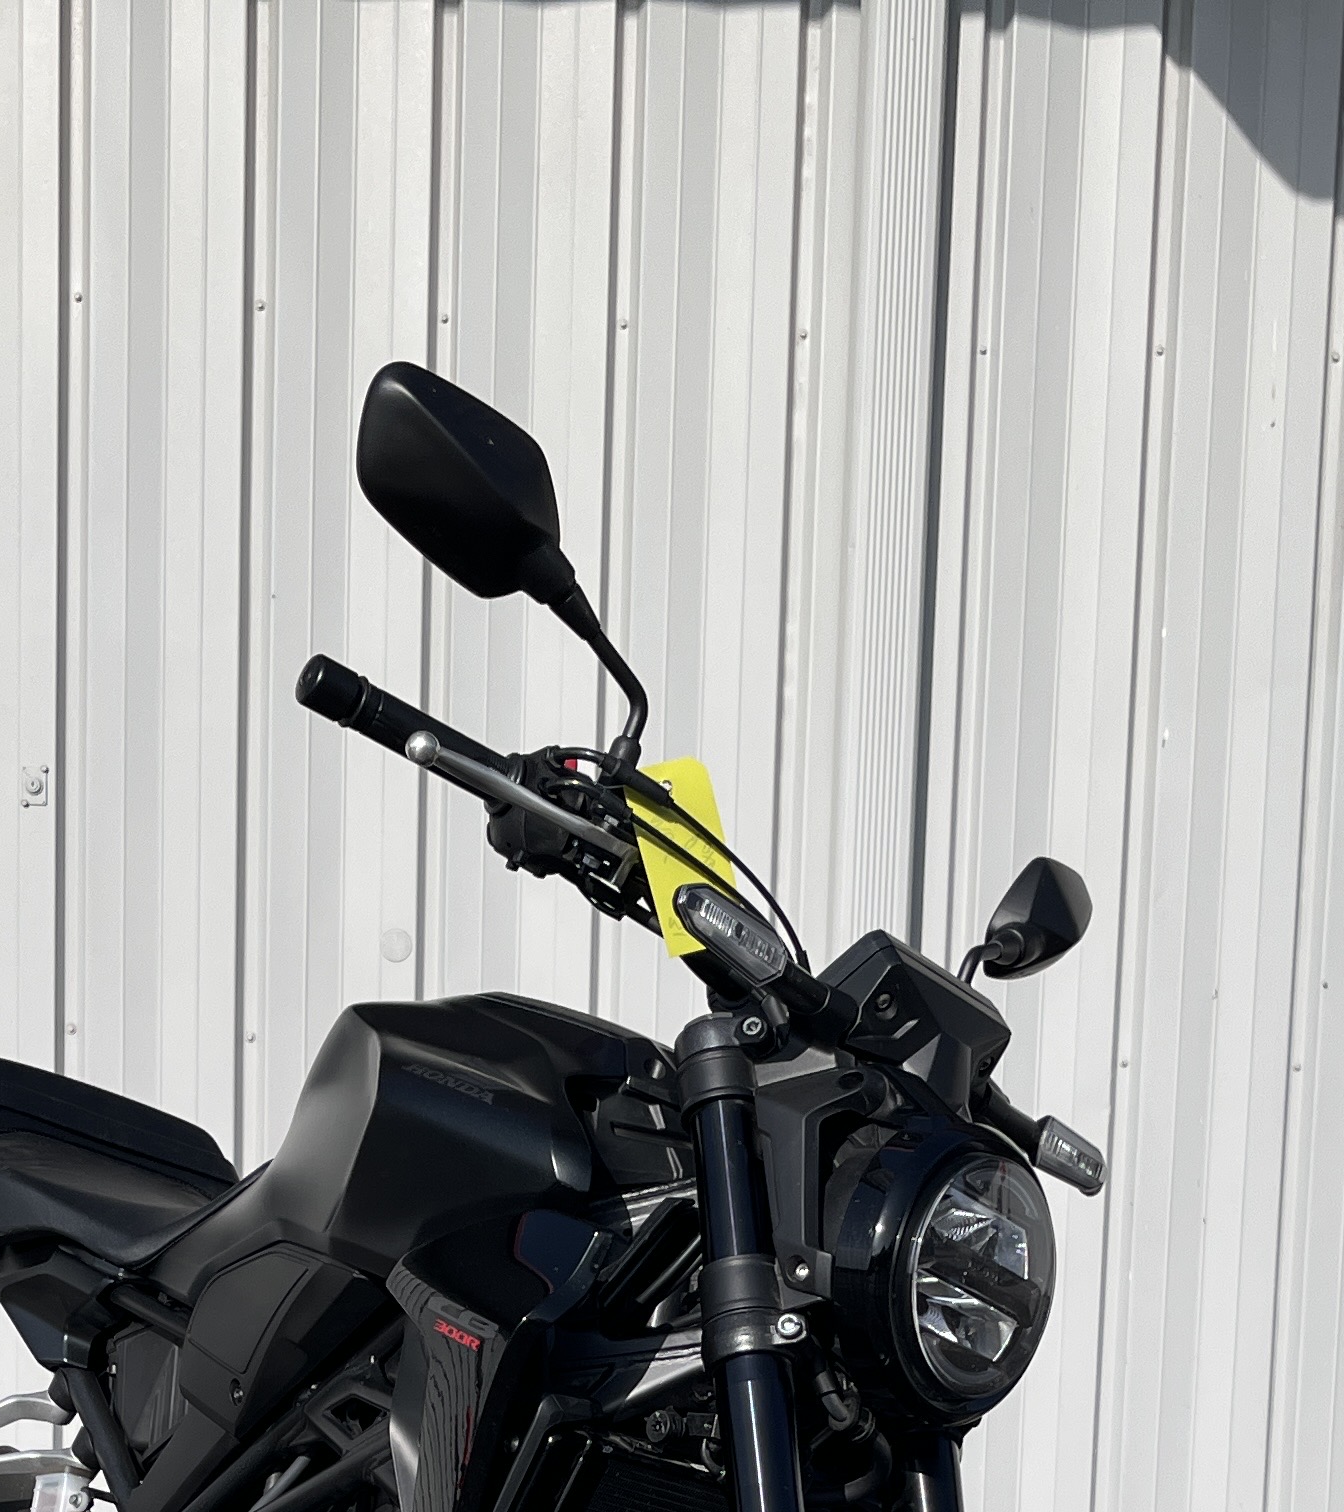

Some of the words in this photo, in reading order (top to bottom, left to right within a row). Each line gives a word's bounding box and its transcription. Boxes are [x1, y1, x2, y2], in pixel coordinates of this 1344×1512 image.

[401, 1064, 494, 1105] HONDA
[428, 1297, 499, 1339] CB
[433, 1317, 482, 1352] 300R
